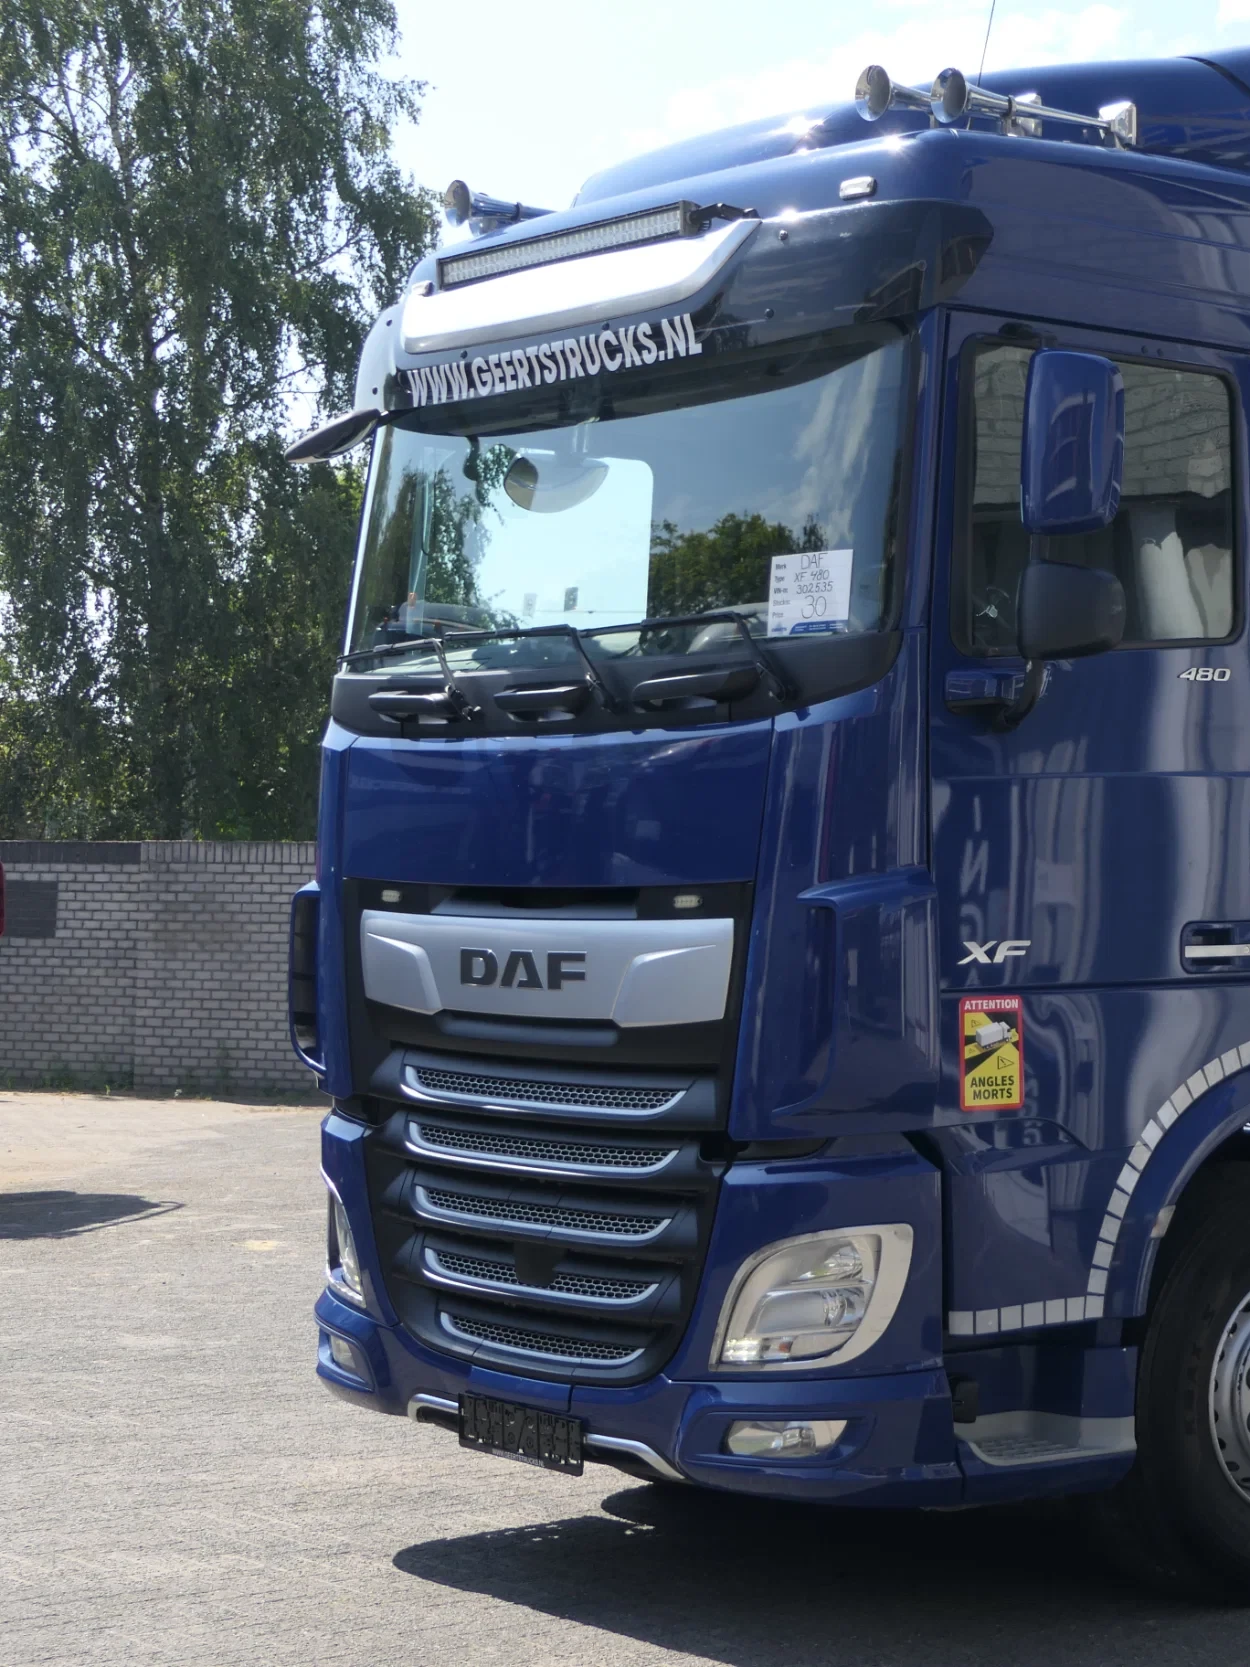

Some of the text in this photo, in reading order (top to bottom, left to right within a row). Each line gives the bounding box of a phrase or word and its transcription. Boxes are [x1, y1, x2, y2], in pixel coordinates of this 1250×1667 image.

[407, 313, 702, 408] WWW.GEERTSTRUCKS.NL
[800, 552, 828, 570] DAF
[793, 569, 830, 583] XF 480
[796, 581, 834, 594] 302535
[800, 594, 827, 619] 30
[1177, 667, 1231, 682] 480
[957, 940, 1031, 965] XF
[459, 946, 587, 990] DAF
[964, 998, 1019, 1011] ATTENTION
[970, 1075, 1015, 1088] ANGLES
[972, 1087, 1013, 1100] MORTS
